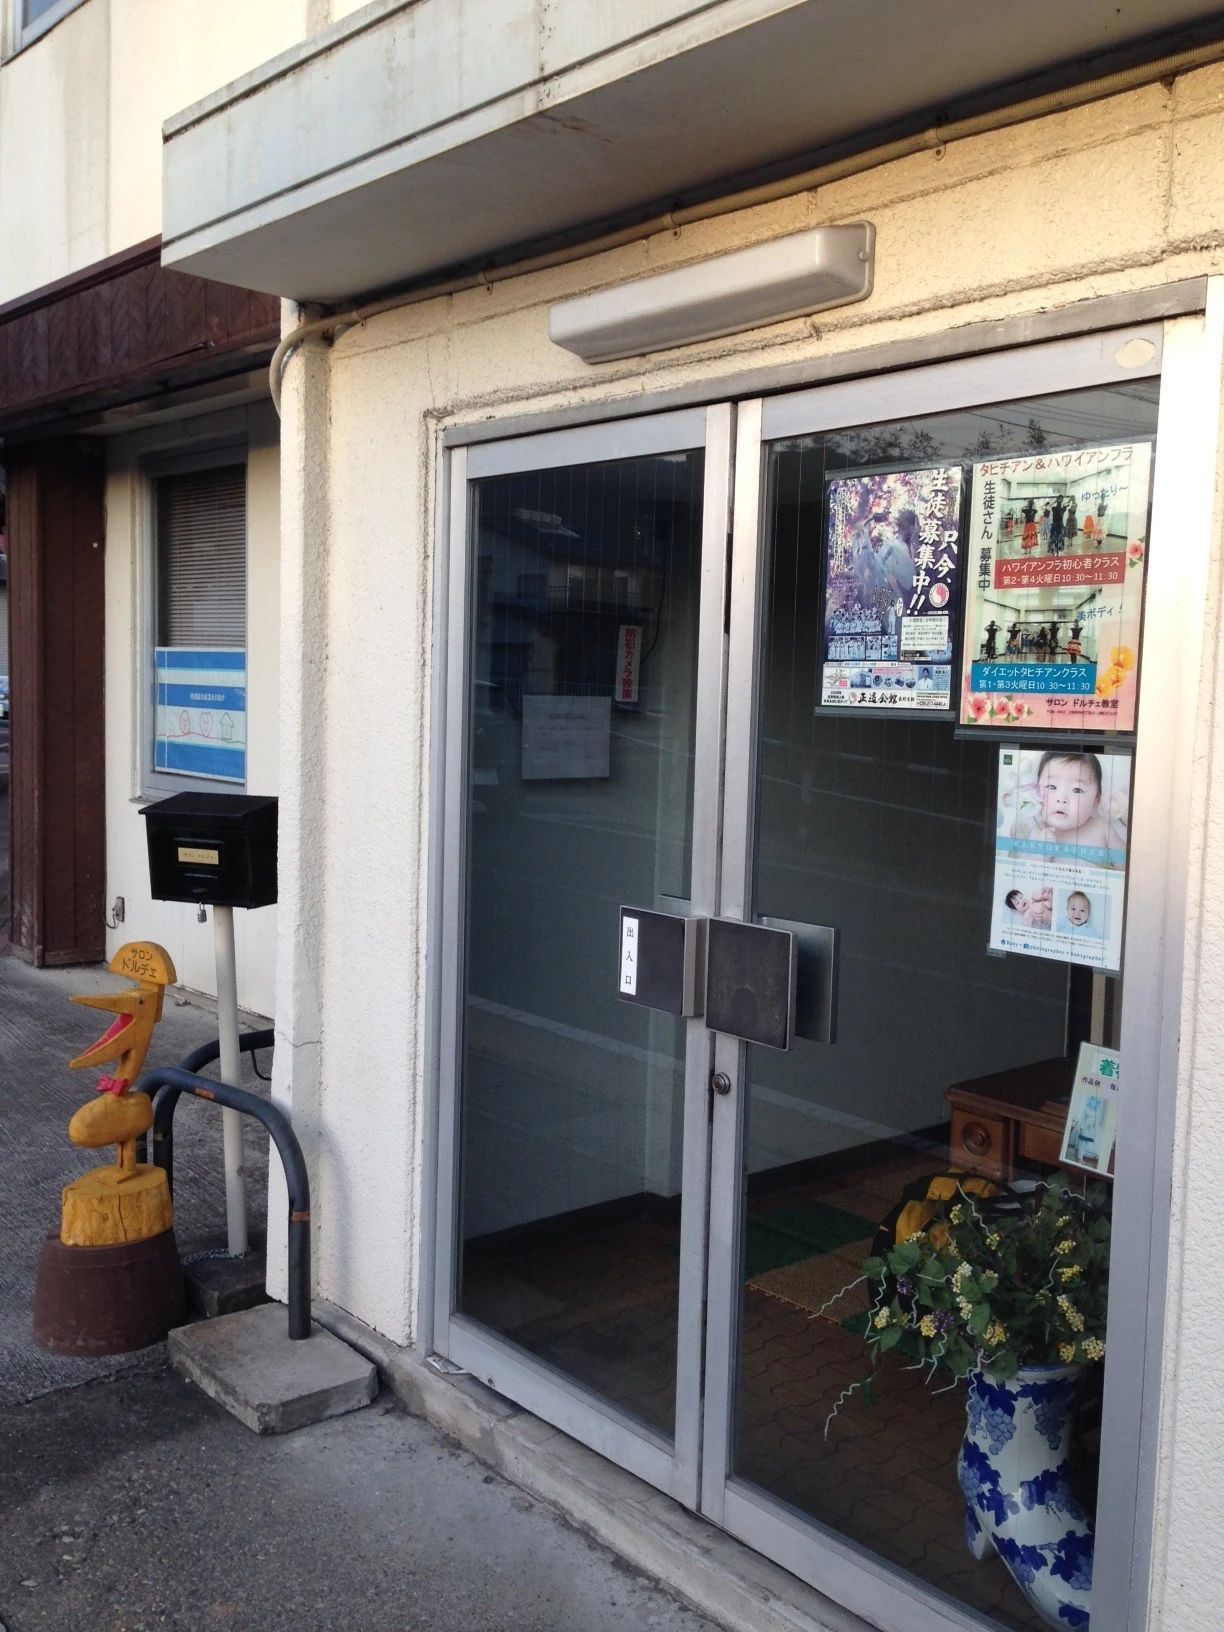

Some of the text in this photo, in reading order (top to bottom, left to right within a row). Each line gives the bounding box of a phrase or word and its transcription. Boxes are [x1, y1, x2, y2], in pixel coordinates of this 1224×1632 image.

[978, 480, 996, 592] 生徒さん 募集中
[1002, 556, 1120, 573] ハワイアンフラ初心者クラス
[982, 666, 1087, 678] ダイエットタヒチアンクラス
[1046, 698, 1119, 709] サロン ドルチェ教室
[131, 947, 153, 961] サロン
[625, 926, 634, 984] 出入口
